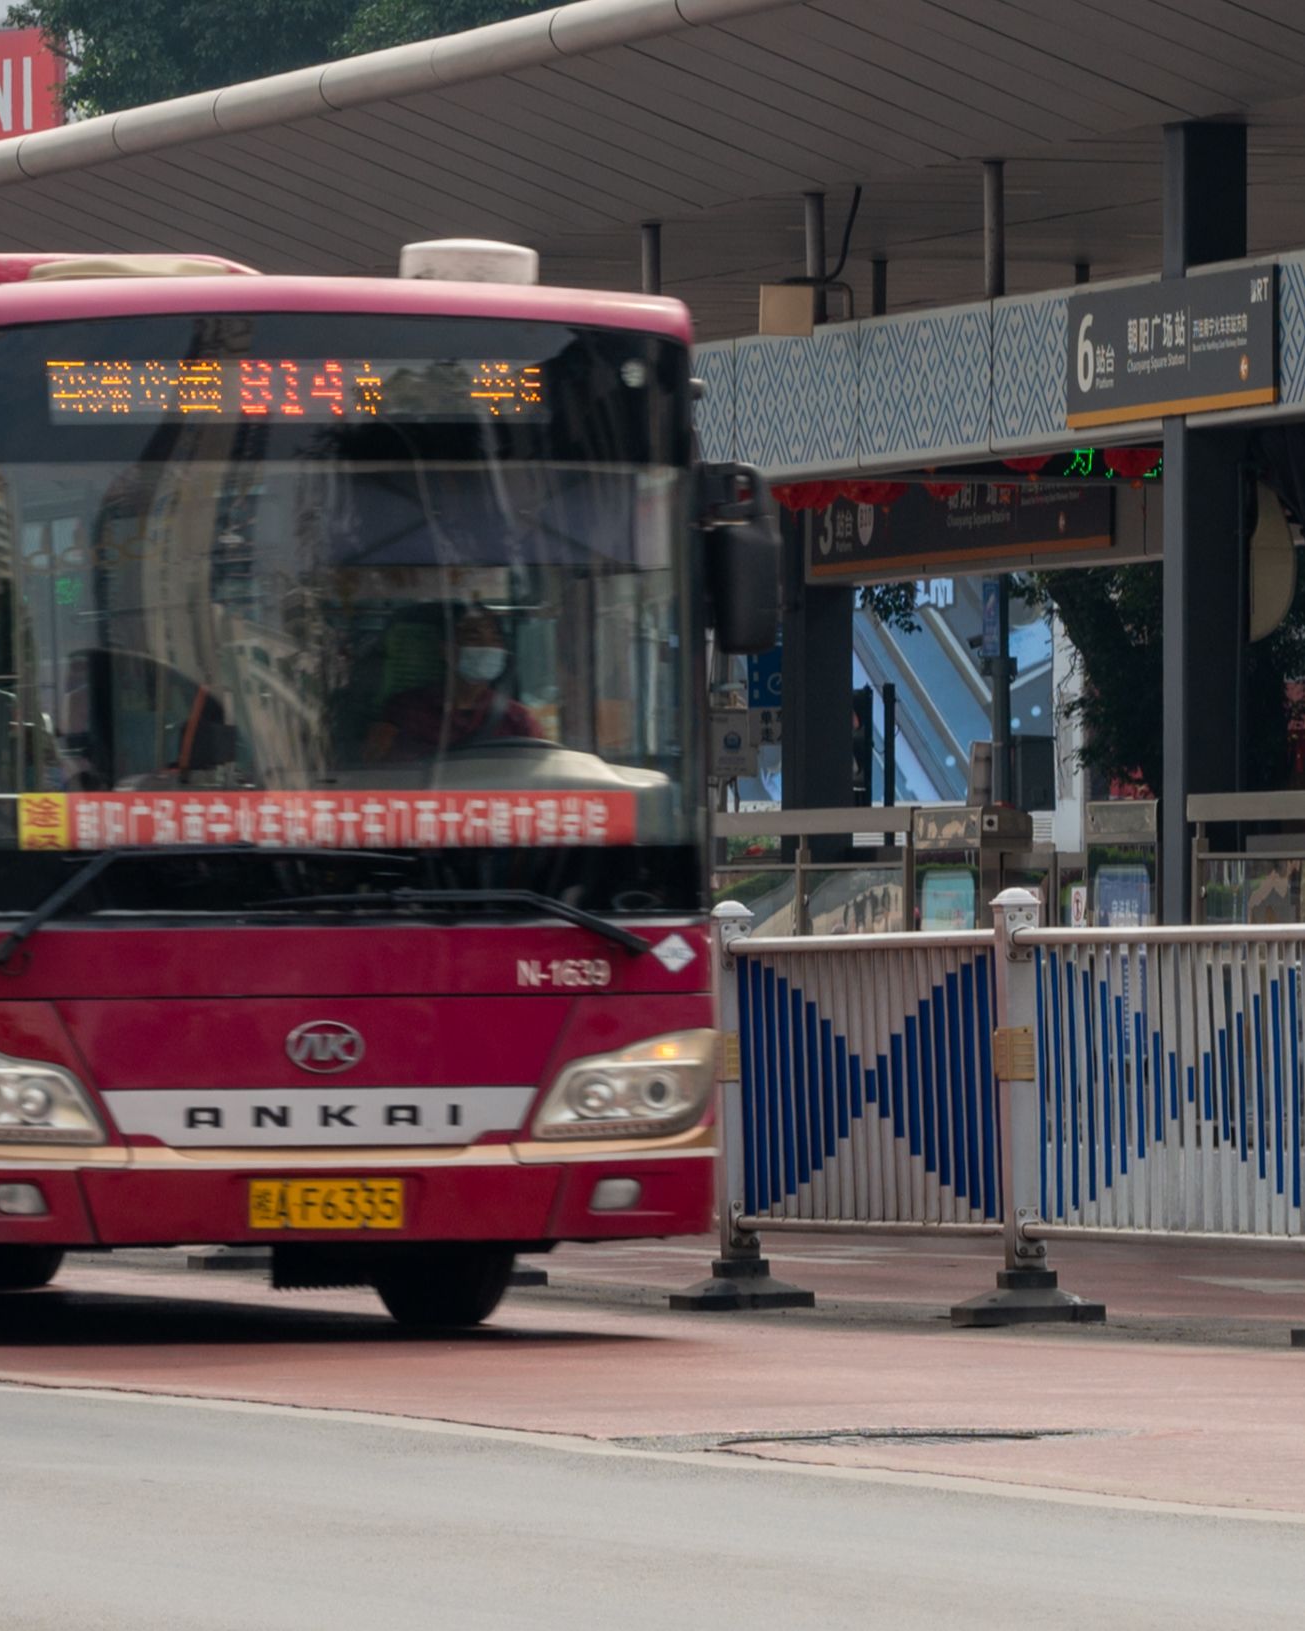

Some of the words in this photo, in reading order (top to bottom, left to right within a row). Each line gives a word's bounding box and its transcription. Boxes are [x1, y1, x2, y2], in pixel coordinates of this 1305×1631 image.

[1127, 309, 1186, 353] 朝阳广场站
[1077, 313, 1094, 393] 6
[1096, 343, 1116, 374] 站台
[1150, 355, 1167, 372] Square
[1168, 353, 1186, 367] Station
[517, 959, 611, 986] N-1639
[185, 1103, 463, 1129] ANKAI
